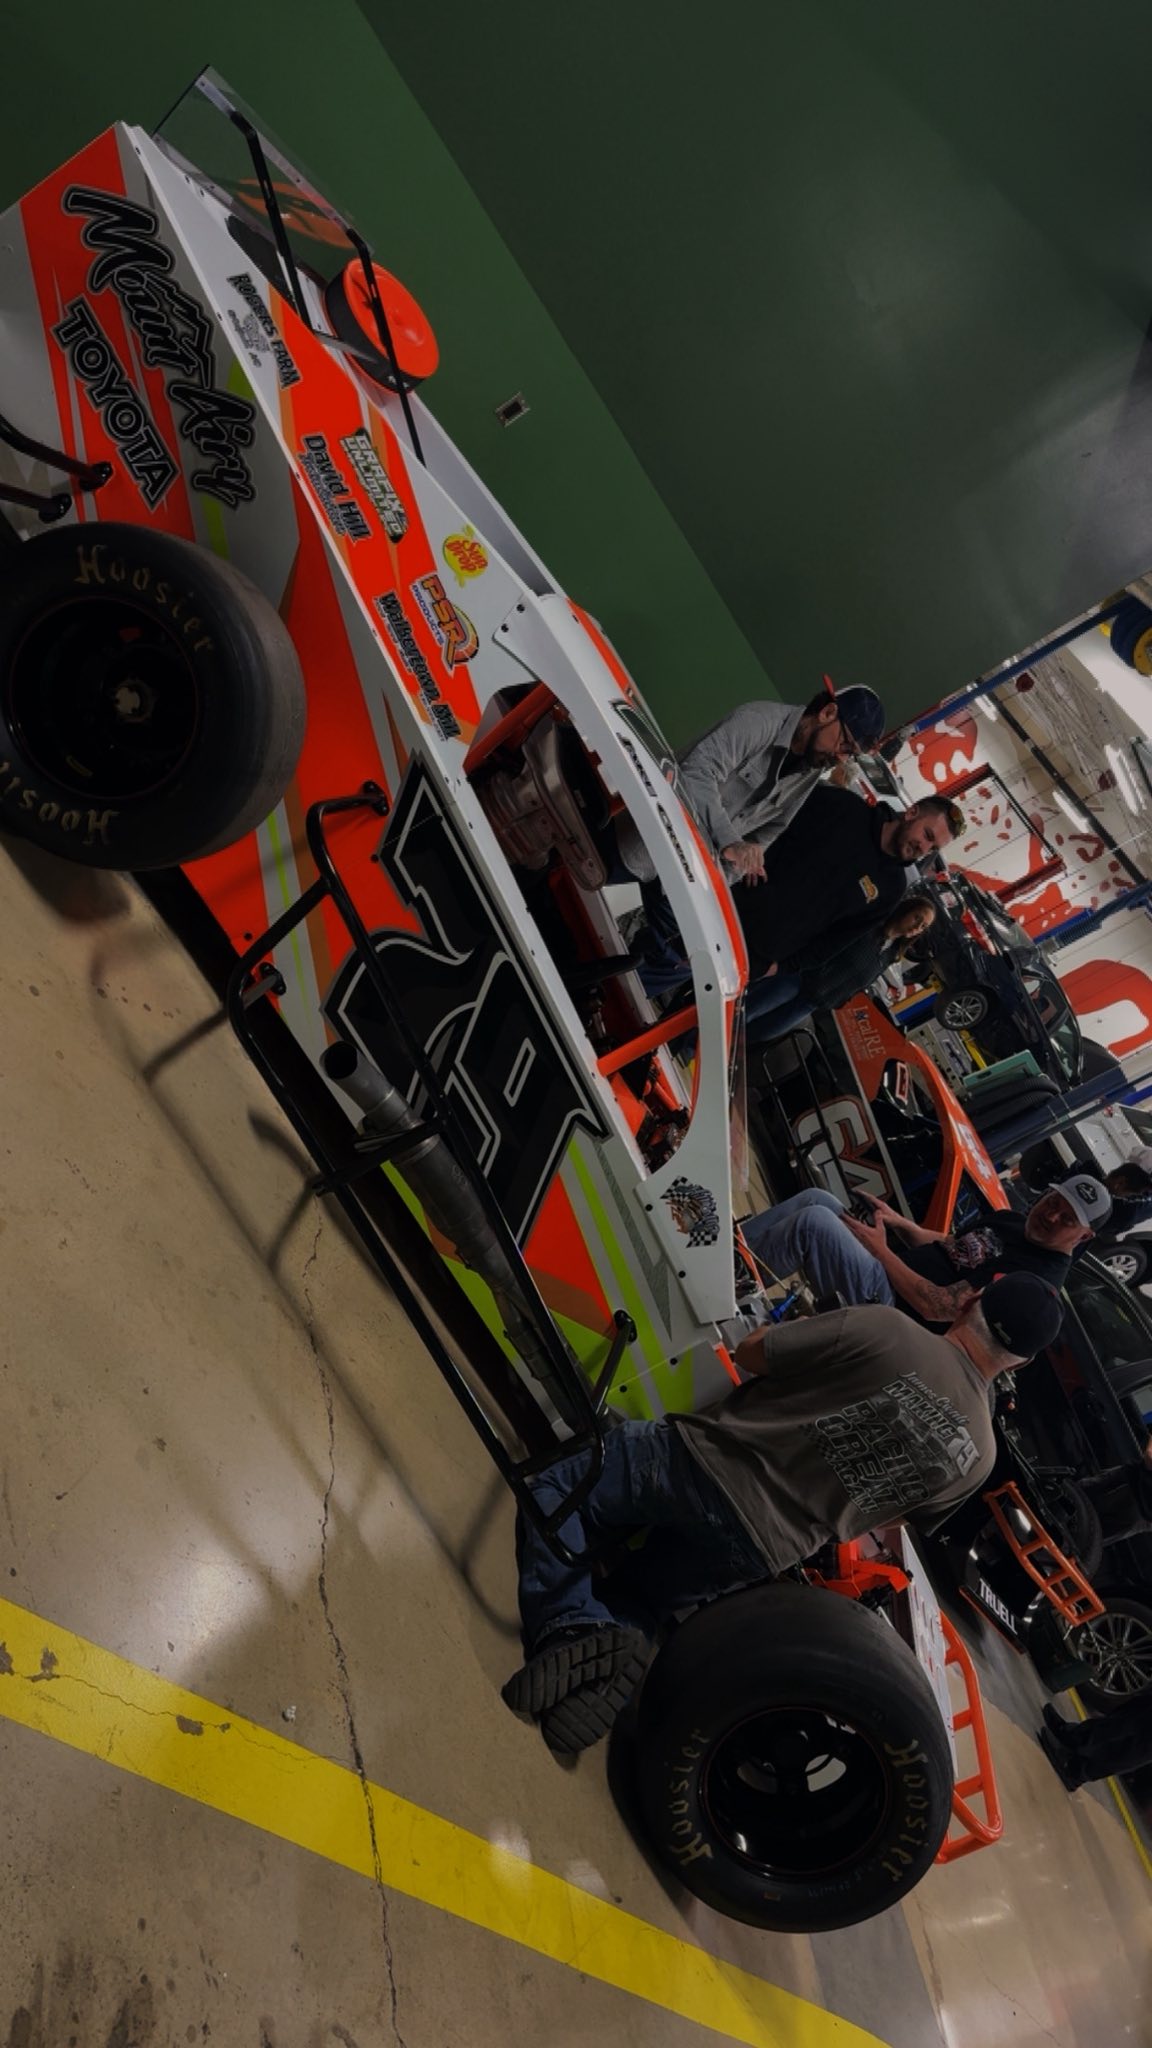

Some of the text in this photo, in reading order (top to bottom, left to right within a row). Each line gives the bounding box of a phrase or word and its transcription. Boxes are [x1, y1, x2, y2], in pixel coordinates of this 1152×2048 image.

[64, 184, 255, 509] Mount Airy
[226, 273, 277, 337] ROGERS
[271, 340, 301, 390] FARM
[57, 302, 176, 506] TOYOTA
[304, 434, 350, 495] David
[339, 501, 371, 538] Hill
[343, 436, 405, 537] UNLIMITED
[354, 434, 403, 513] GRAFIX
[73, 543, 214, 652] Hoosier
[411, 584, 445, 644] PRODUCTS
[421, 574, 467, 670] PSR
[324, 752, 611, 1250] 79
[815, 1413, 909, 1508] GREAT
[842, 1399, 931, 1501] RACING
[882, 1379, 982, 1477] MAKING 79
[668, 1728, 714, 1867] Hoosier
[881, 1736, 931, 1883] Hoosier
